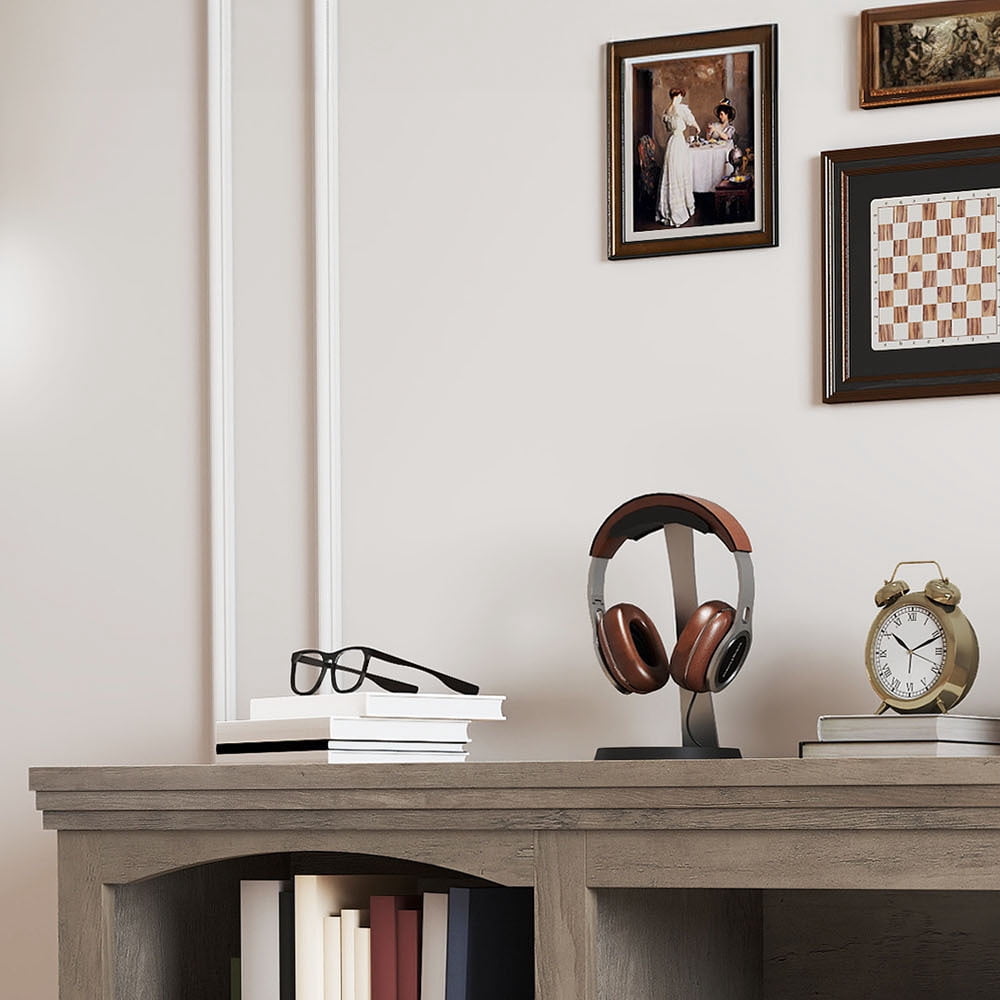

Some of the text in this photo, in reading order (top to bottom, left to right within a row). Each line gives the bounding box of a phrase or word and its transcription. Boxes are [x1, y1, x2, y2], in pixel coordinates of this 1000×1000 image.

[907, 613, 917, 622] XII
[879, 649, 888, 658] IX
[935, 647, 943, 656] III
[882, 663, 893, 678] VIII
[891, 676, 902, 690] VII
[906, 682, 914, 692] VI
